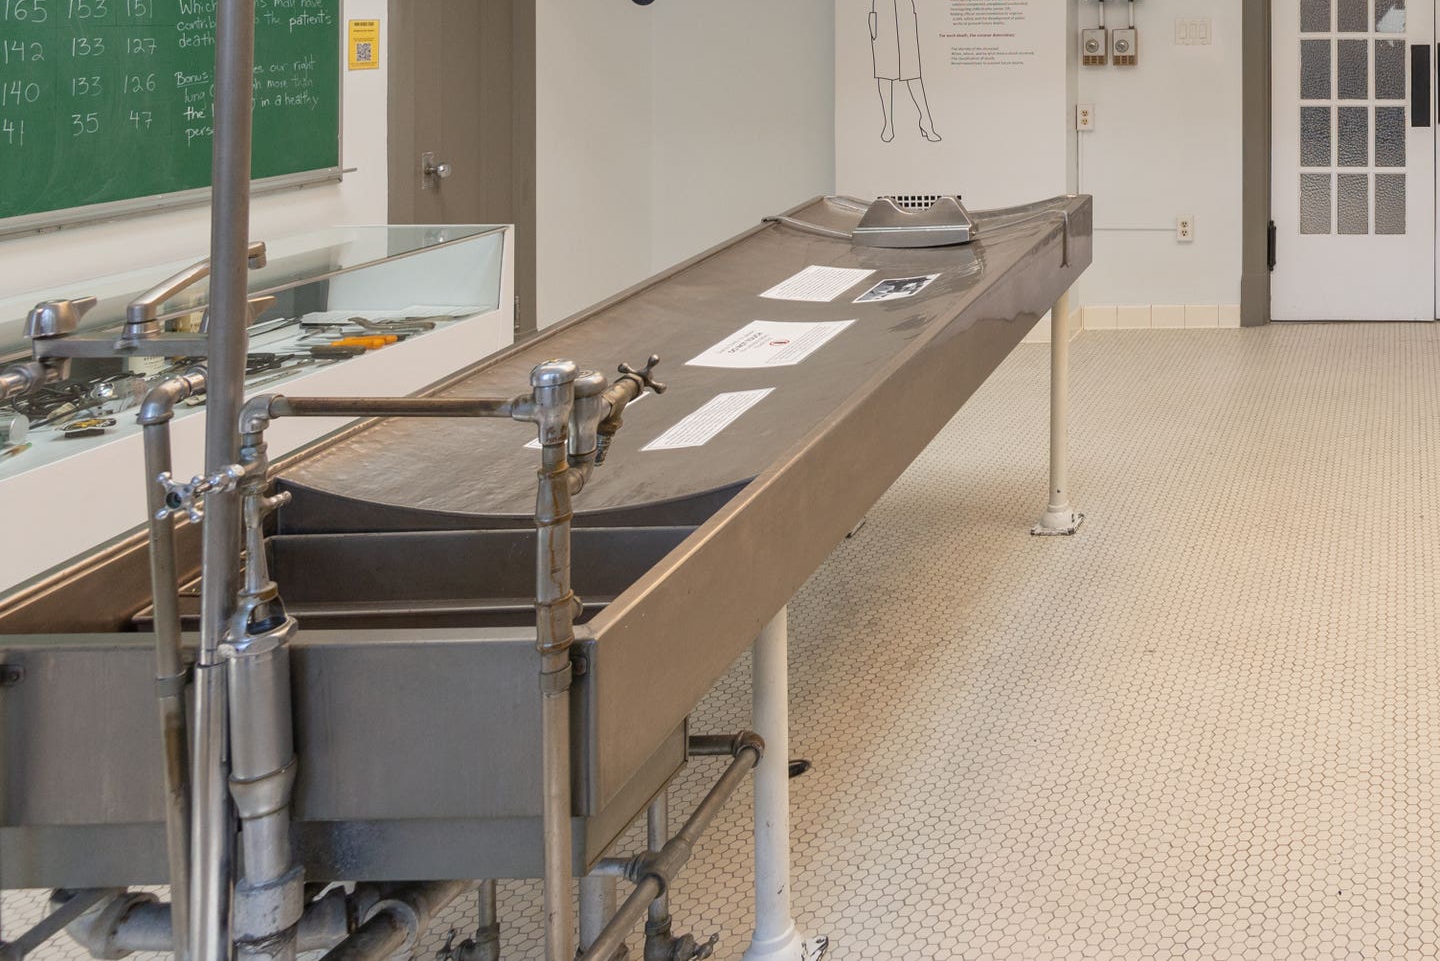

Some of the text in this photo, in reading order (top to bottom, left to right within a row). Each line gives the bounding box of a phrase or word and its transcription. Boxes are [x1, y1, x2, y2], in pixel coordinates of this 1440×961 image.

[176, 16, 217, 32] contrib
[4, 37, 158, 65] 142 133 127
[270, 64, 286, 73] our
[2, 73, 156, 106] 140 133 126
[184, 87, 206, 112] lung
[183, 89, 320, 121] the in a healthy
[3, 109, 154, 147] 41 35 47
[184, 125, 216, 148] pers
